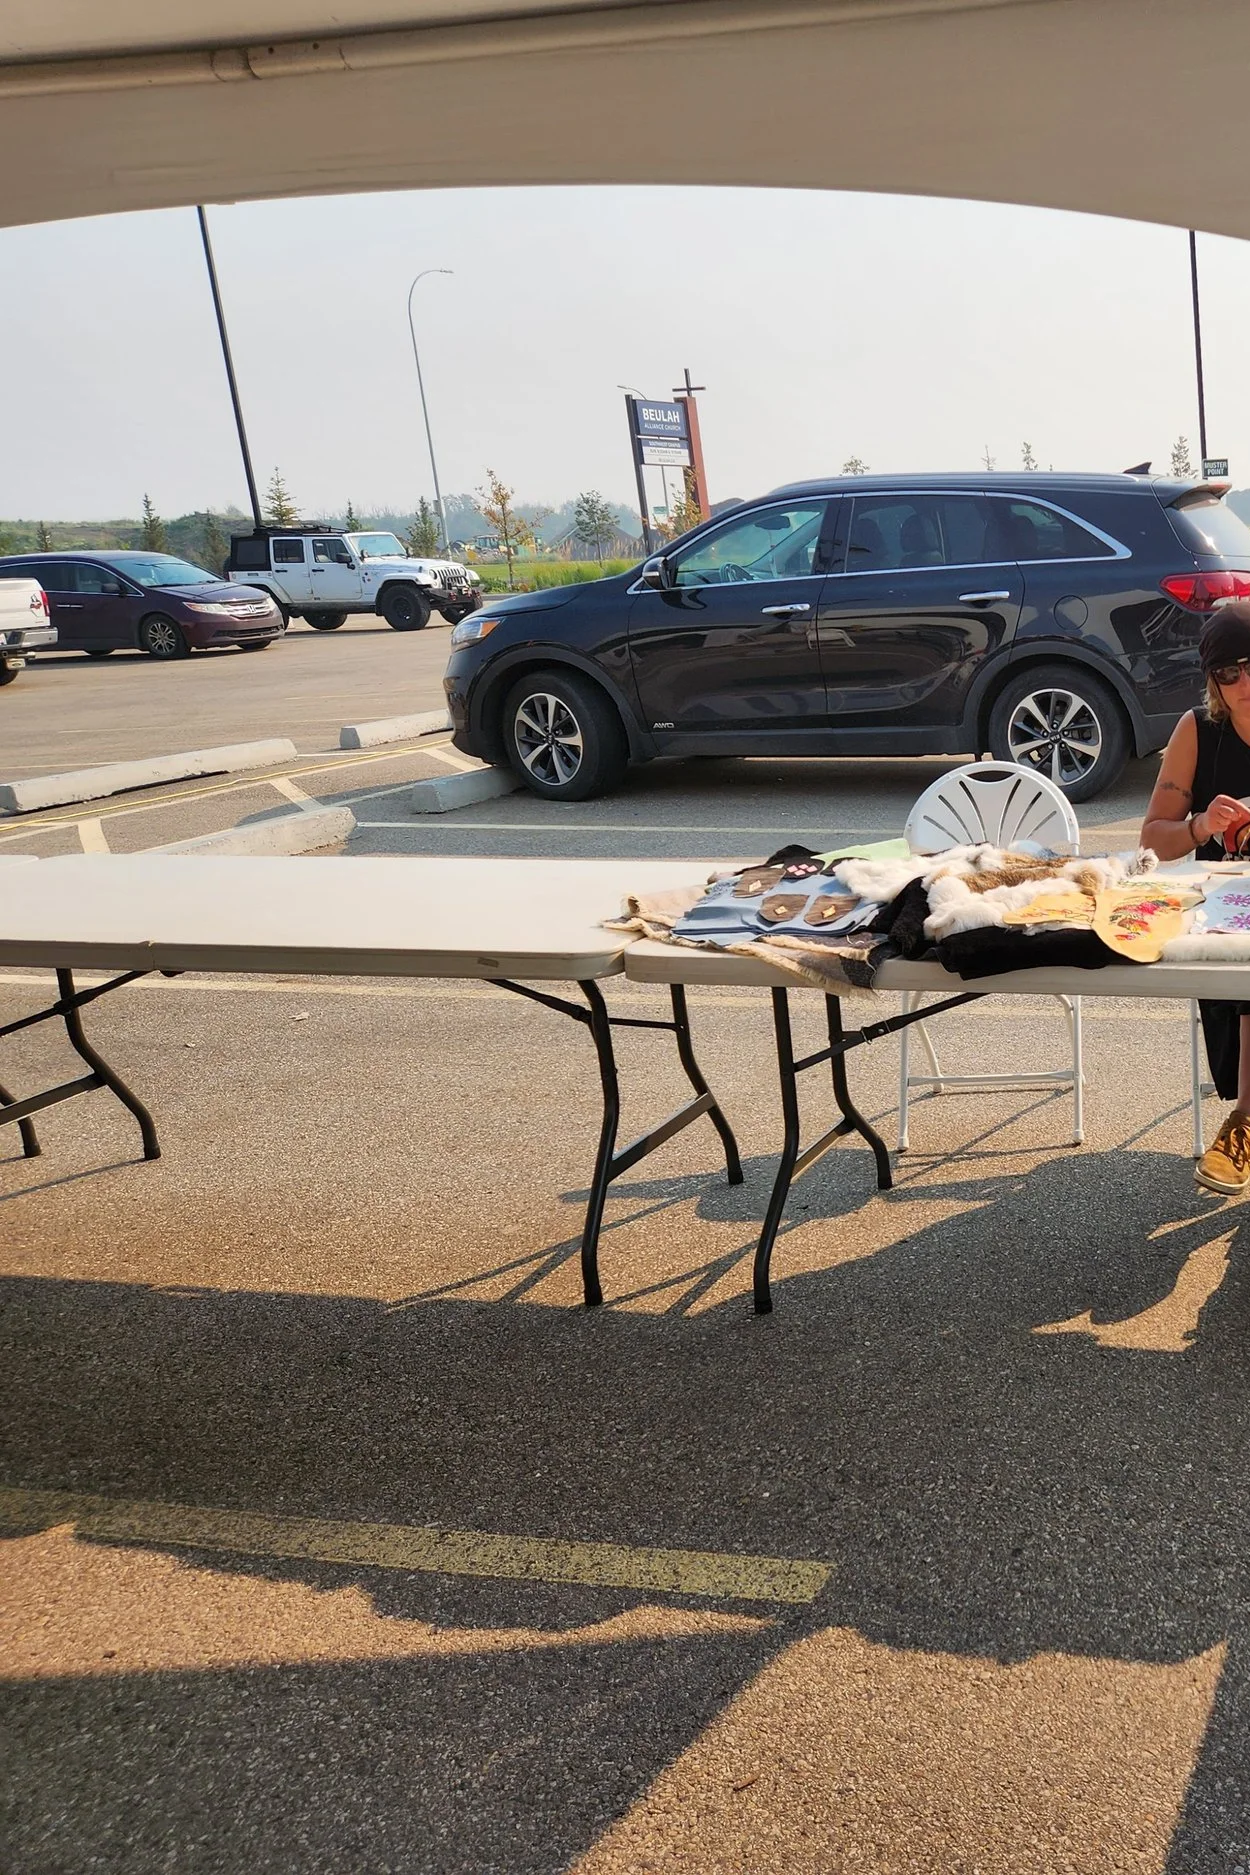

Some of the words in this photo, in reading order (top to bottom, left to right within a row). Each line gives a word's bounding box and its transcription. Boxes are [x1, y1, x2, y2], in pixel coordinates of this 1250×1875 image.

[642, 408, 680, 423] BEULAH
[664, 424, 682, 432] CHURCH
[1204, 461, 1228, 469] MUSTER
[1207, 468, 1224, 476] POINT
